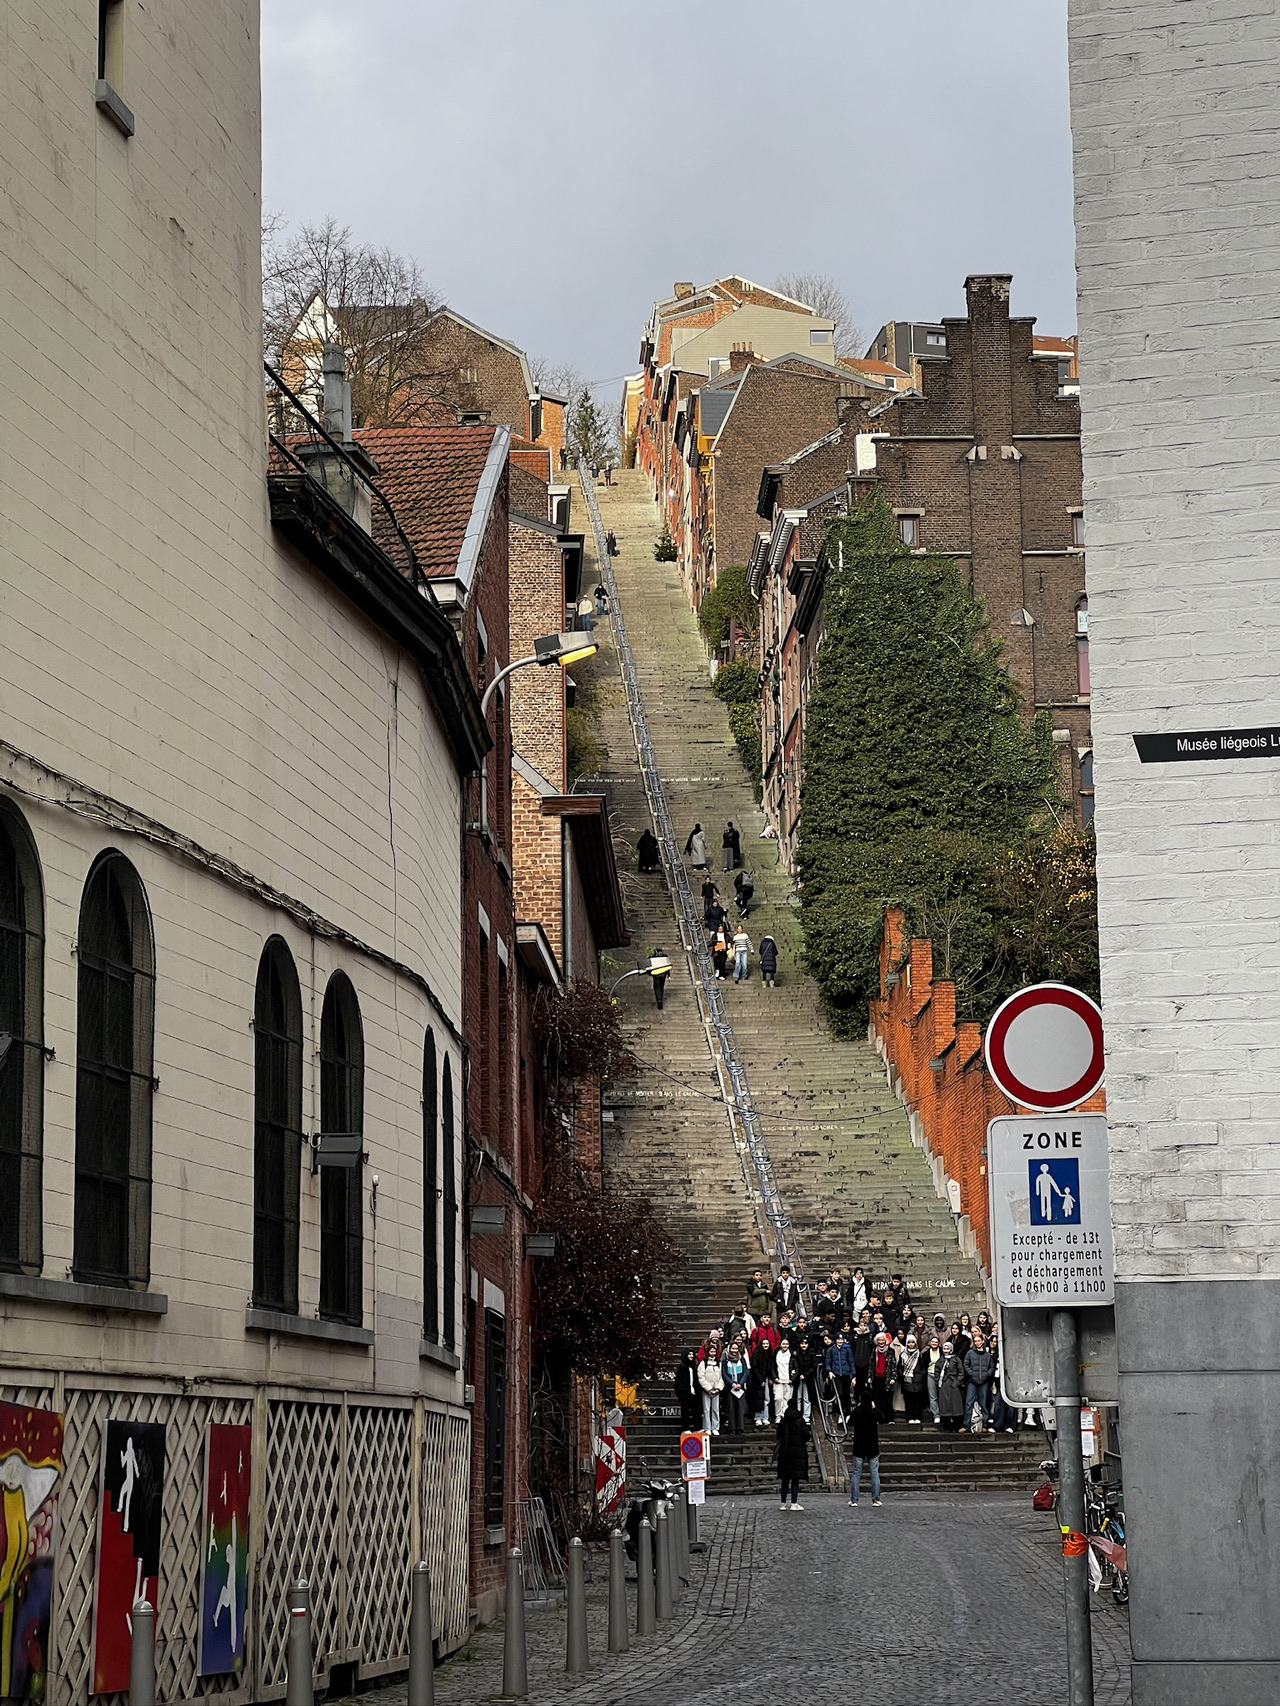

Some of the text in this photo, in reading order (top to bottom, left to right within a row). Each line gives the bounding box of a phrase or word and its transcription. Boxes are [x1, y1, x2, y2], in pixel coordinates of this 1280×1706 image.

[1176, 737, 1218, 752] Musée
[1220, 734, 1268, 752] liégeois
[1022, 1131, 1082, 1150] ZONE
[1012, 1231, 1054, 1248] Excepté
[1065, 1231, 1078, 1245] de
[1082, 1231, 1100, 1244] 13t
[1010, 1248, 1103, 1264] pour chargement
[1012, 1264, 1103, 1280] et déchargement
[906, 1280, 923, 1289] DANS
[925, 1280, 933, 1288] LE
[935, 1279, 956, 1288] CALME
[1010, 1280, 1106, 1293] de 06h00 à 11h00
